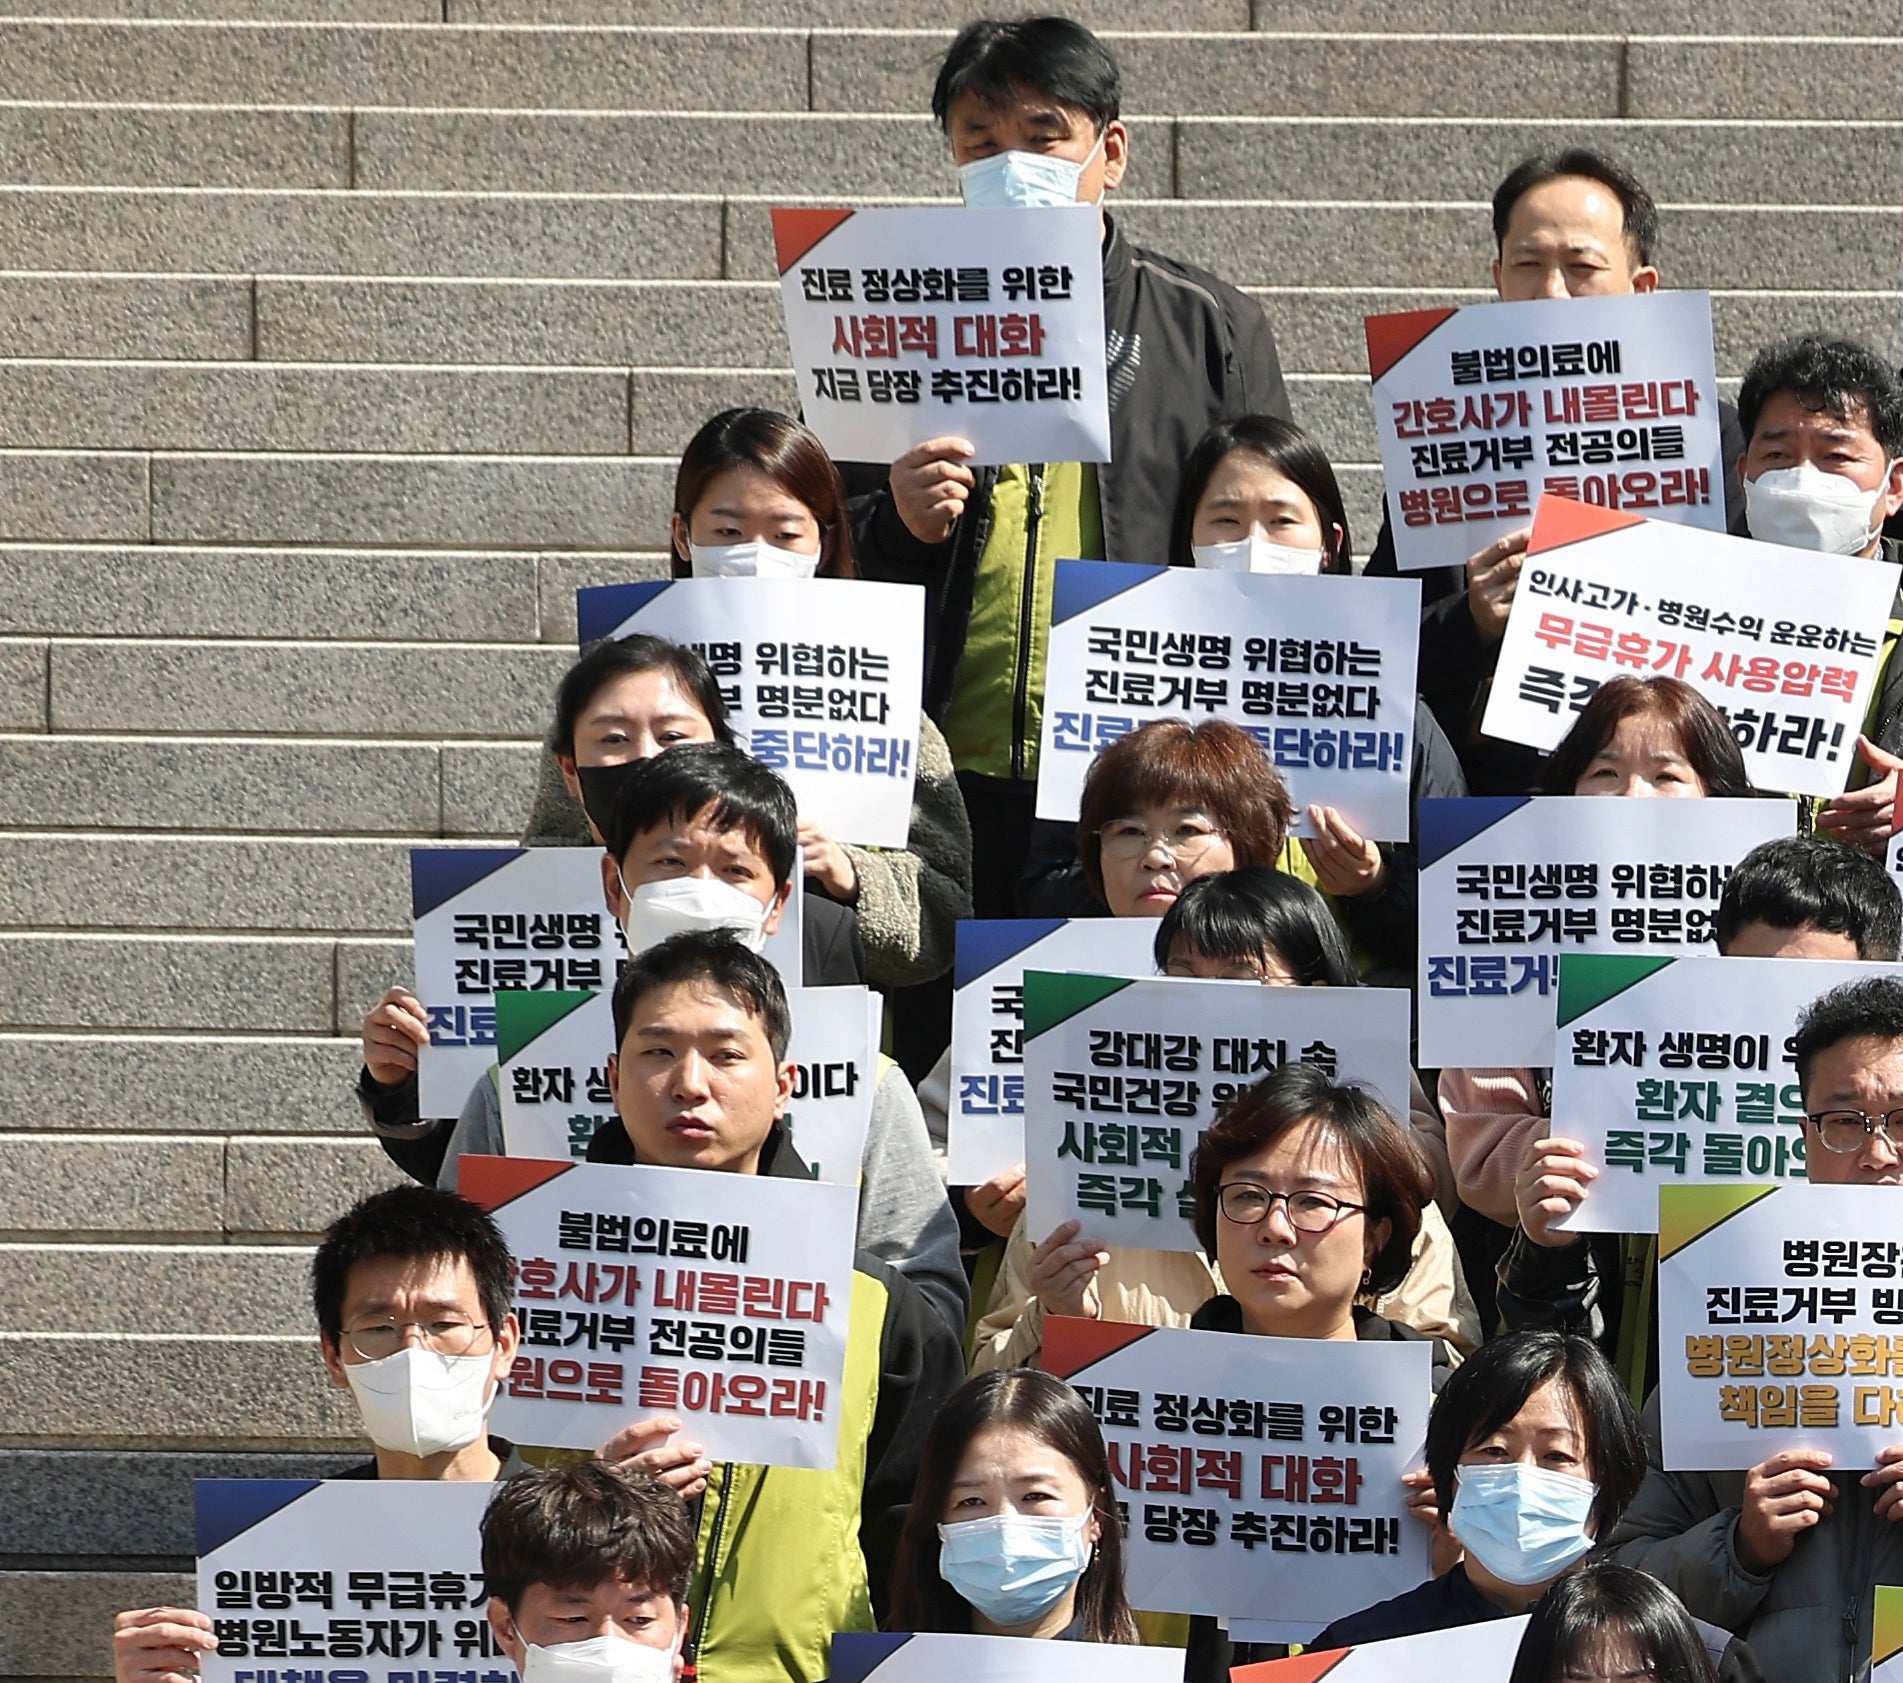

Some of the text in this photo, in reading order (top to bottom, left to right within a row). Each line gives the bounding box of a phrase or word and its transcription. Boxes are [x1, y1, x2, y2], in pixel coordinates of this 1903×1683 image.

[800, 265, 1073, 303] 진료 정상화를 위한
[832, 313, 1046, 361] 사회적 대화
[811, 367, 1081, 405] 지금 당장 추진하라!
[1088, 626, 1381, 678] 국민생명 위협하는
[1534, 612, 1858, 704] 무급휴가 사용압력
[558, 1210, 749, 1264] 불법의료에
[653, 1268, 830, 1324] 내몰린다
[1706, 1286, 1857, 1325] 진료거부
[648, 1318, 805, 1368] 전공의들
[638, 1365, 826, 1422] 돌아오라!
[1719, 1384, 1840, 1430] 책임을
